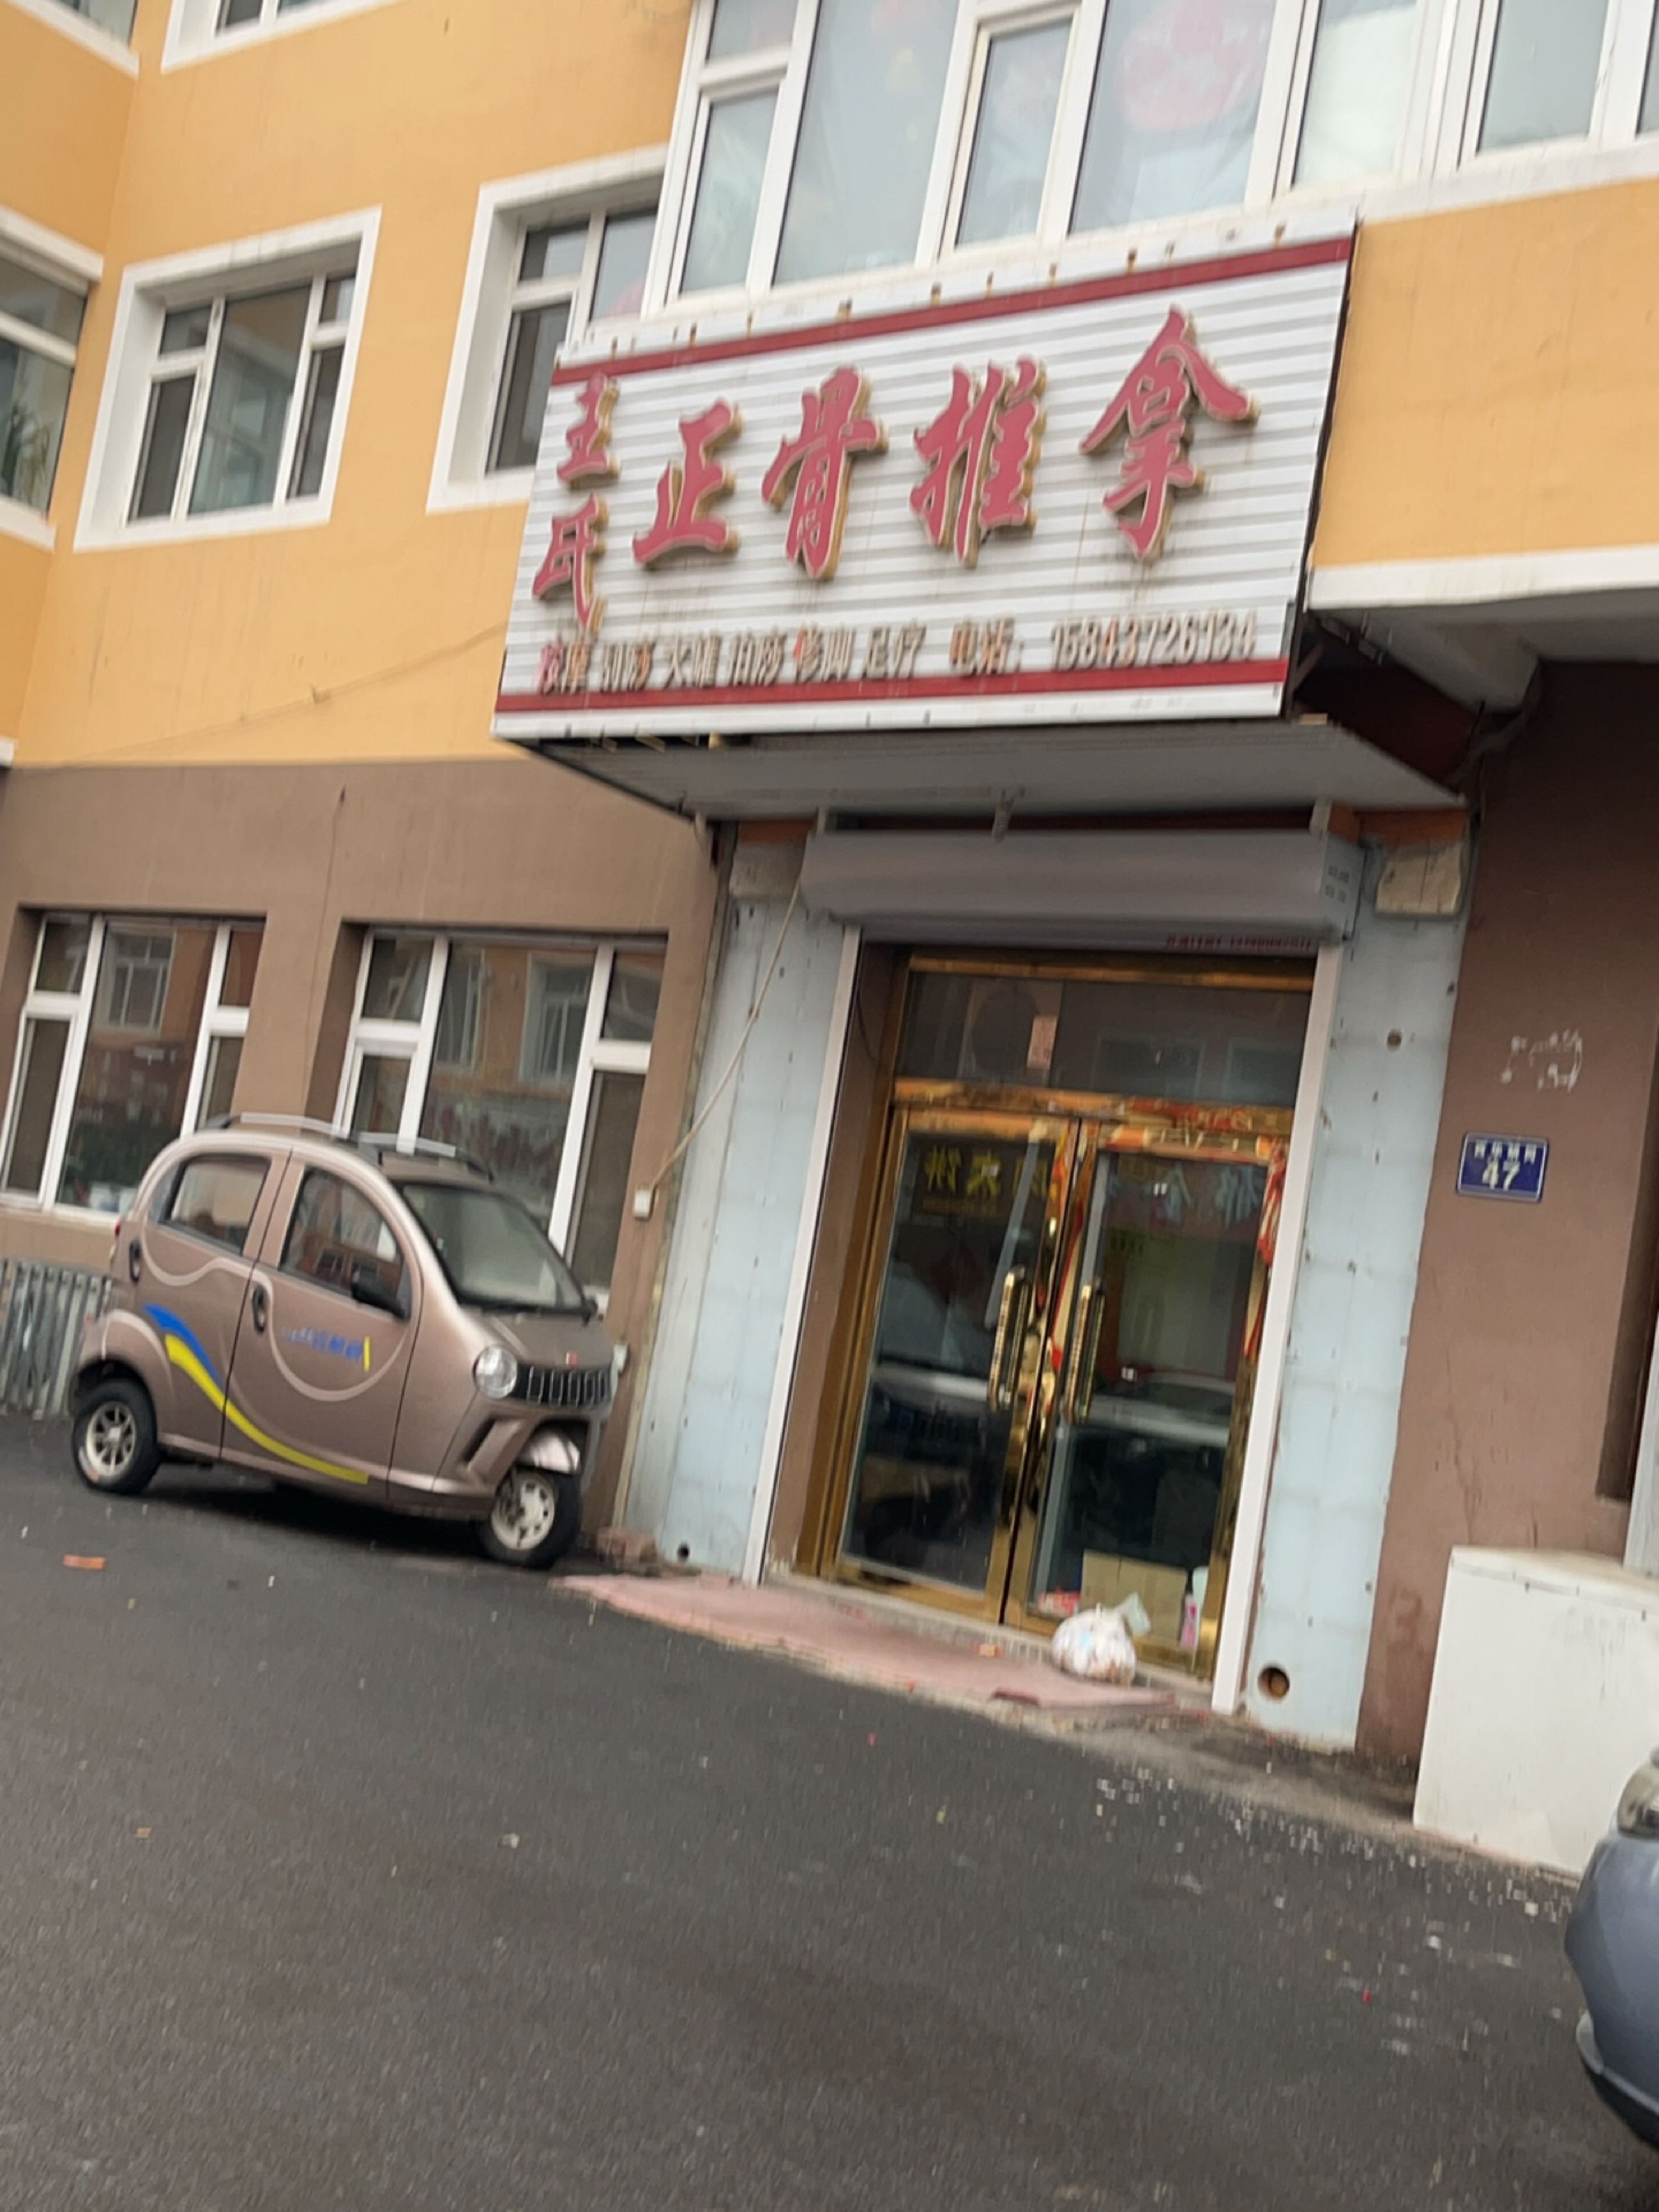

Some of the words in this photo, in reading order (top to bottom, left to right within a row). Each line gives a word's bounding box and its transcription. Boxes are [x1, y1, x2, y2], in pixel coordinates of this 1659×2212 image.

[532, 371, 617, 638] 王氏
[632, 303, 1256, 580] 正骨推拿
[666, 634, 721, 690] 火罐
[1050, 609, 1258, 672] 15843726134
[1482, 1155, 1521, 1191] 47
